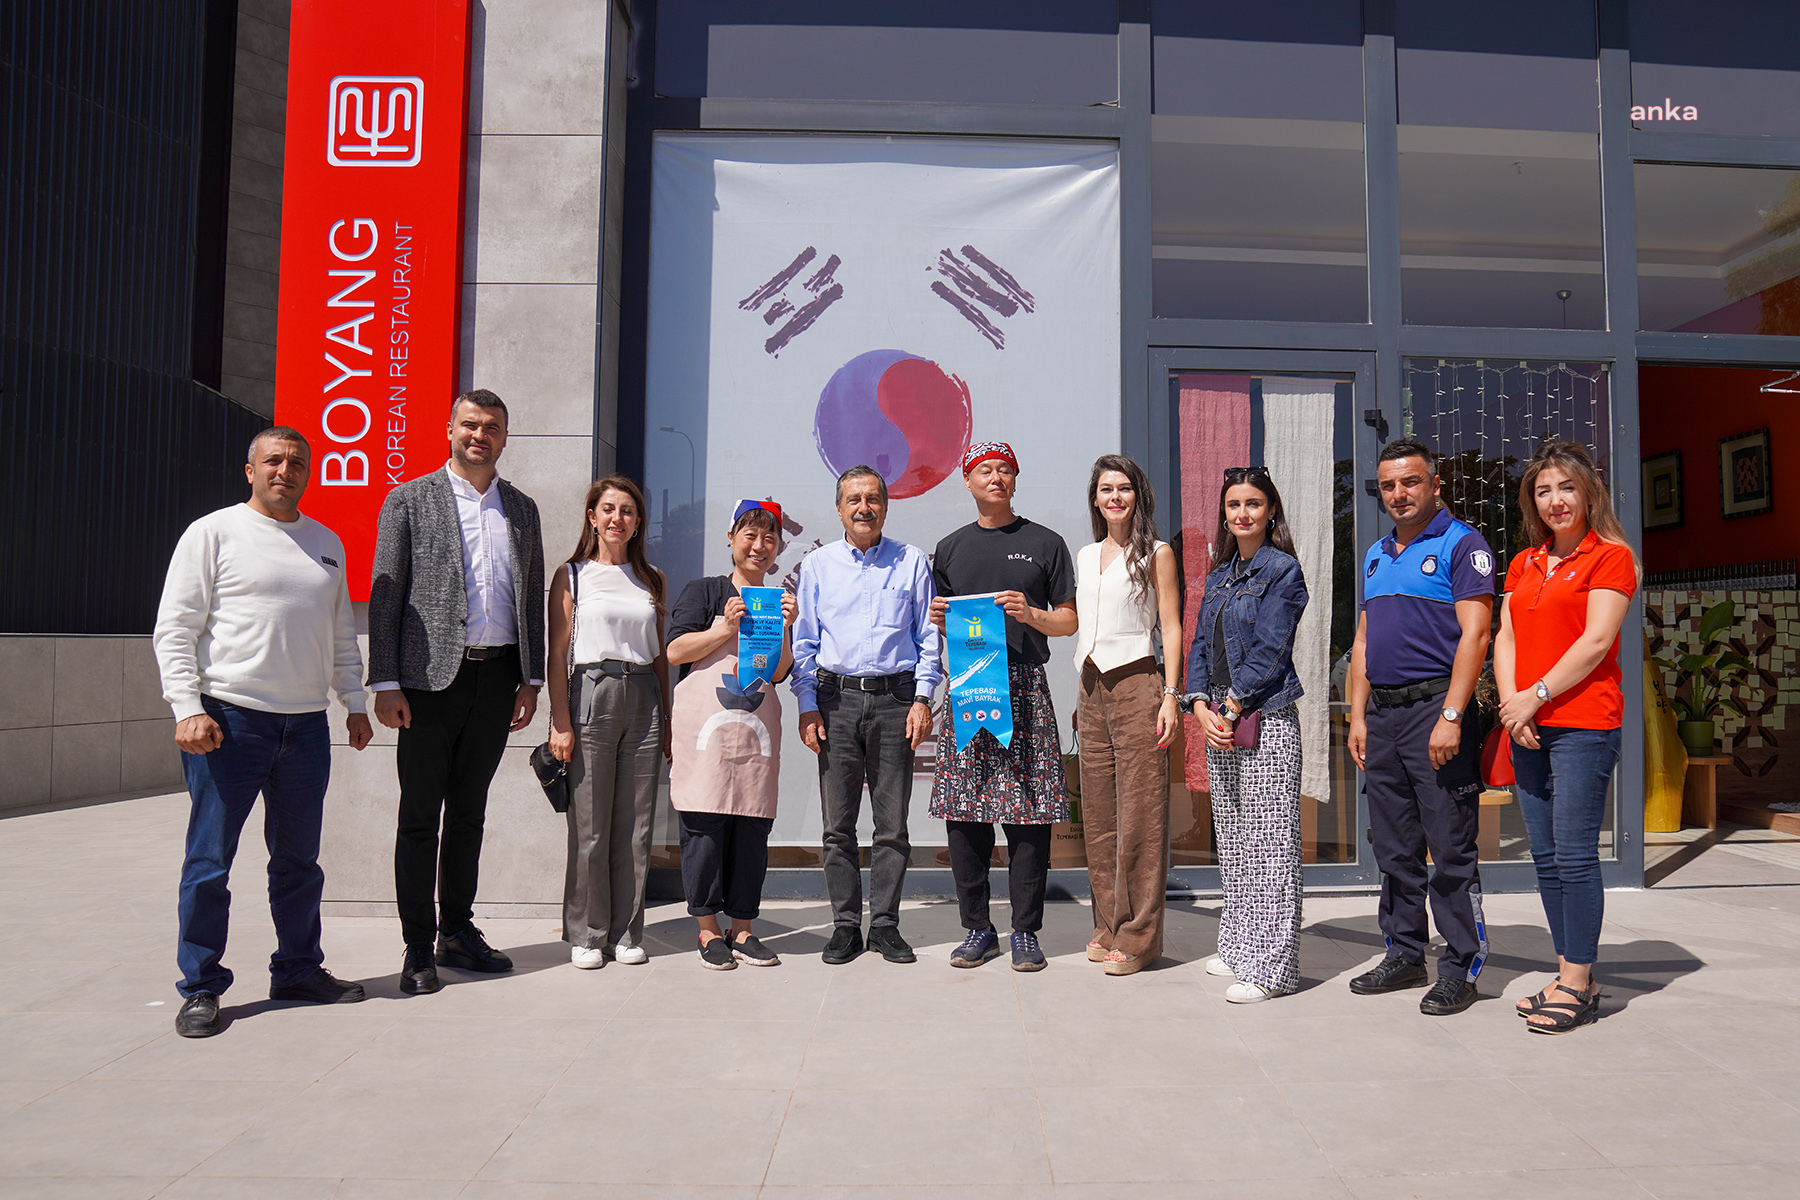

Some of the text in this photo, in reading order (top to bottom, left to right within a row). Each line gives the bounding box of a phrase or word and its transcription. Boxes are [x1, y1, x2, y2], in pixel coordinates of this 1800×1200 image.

[320, 218, 379, 487] BOYANG
[386, 220, 413, 485] KOREAN RESTAURANT
[960, 687, 997, 698] TEPEBAŞI
[974, 694, 1002, 704] BAYRAK
